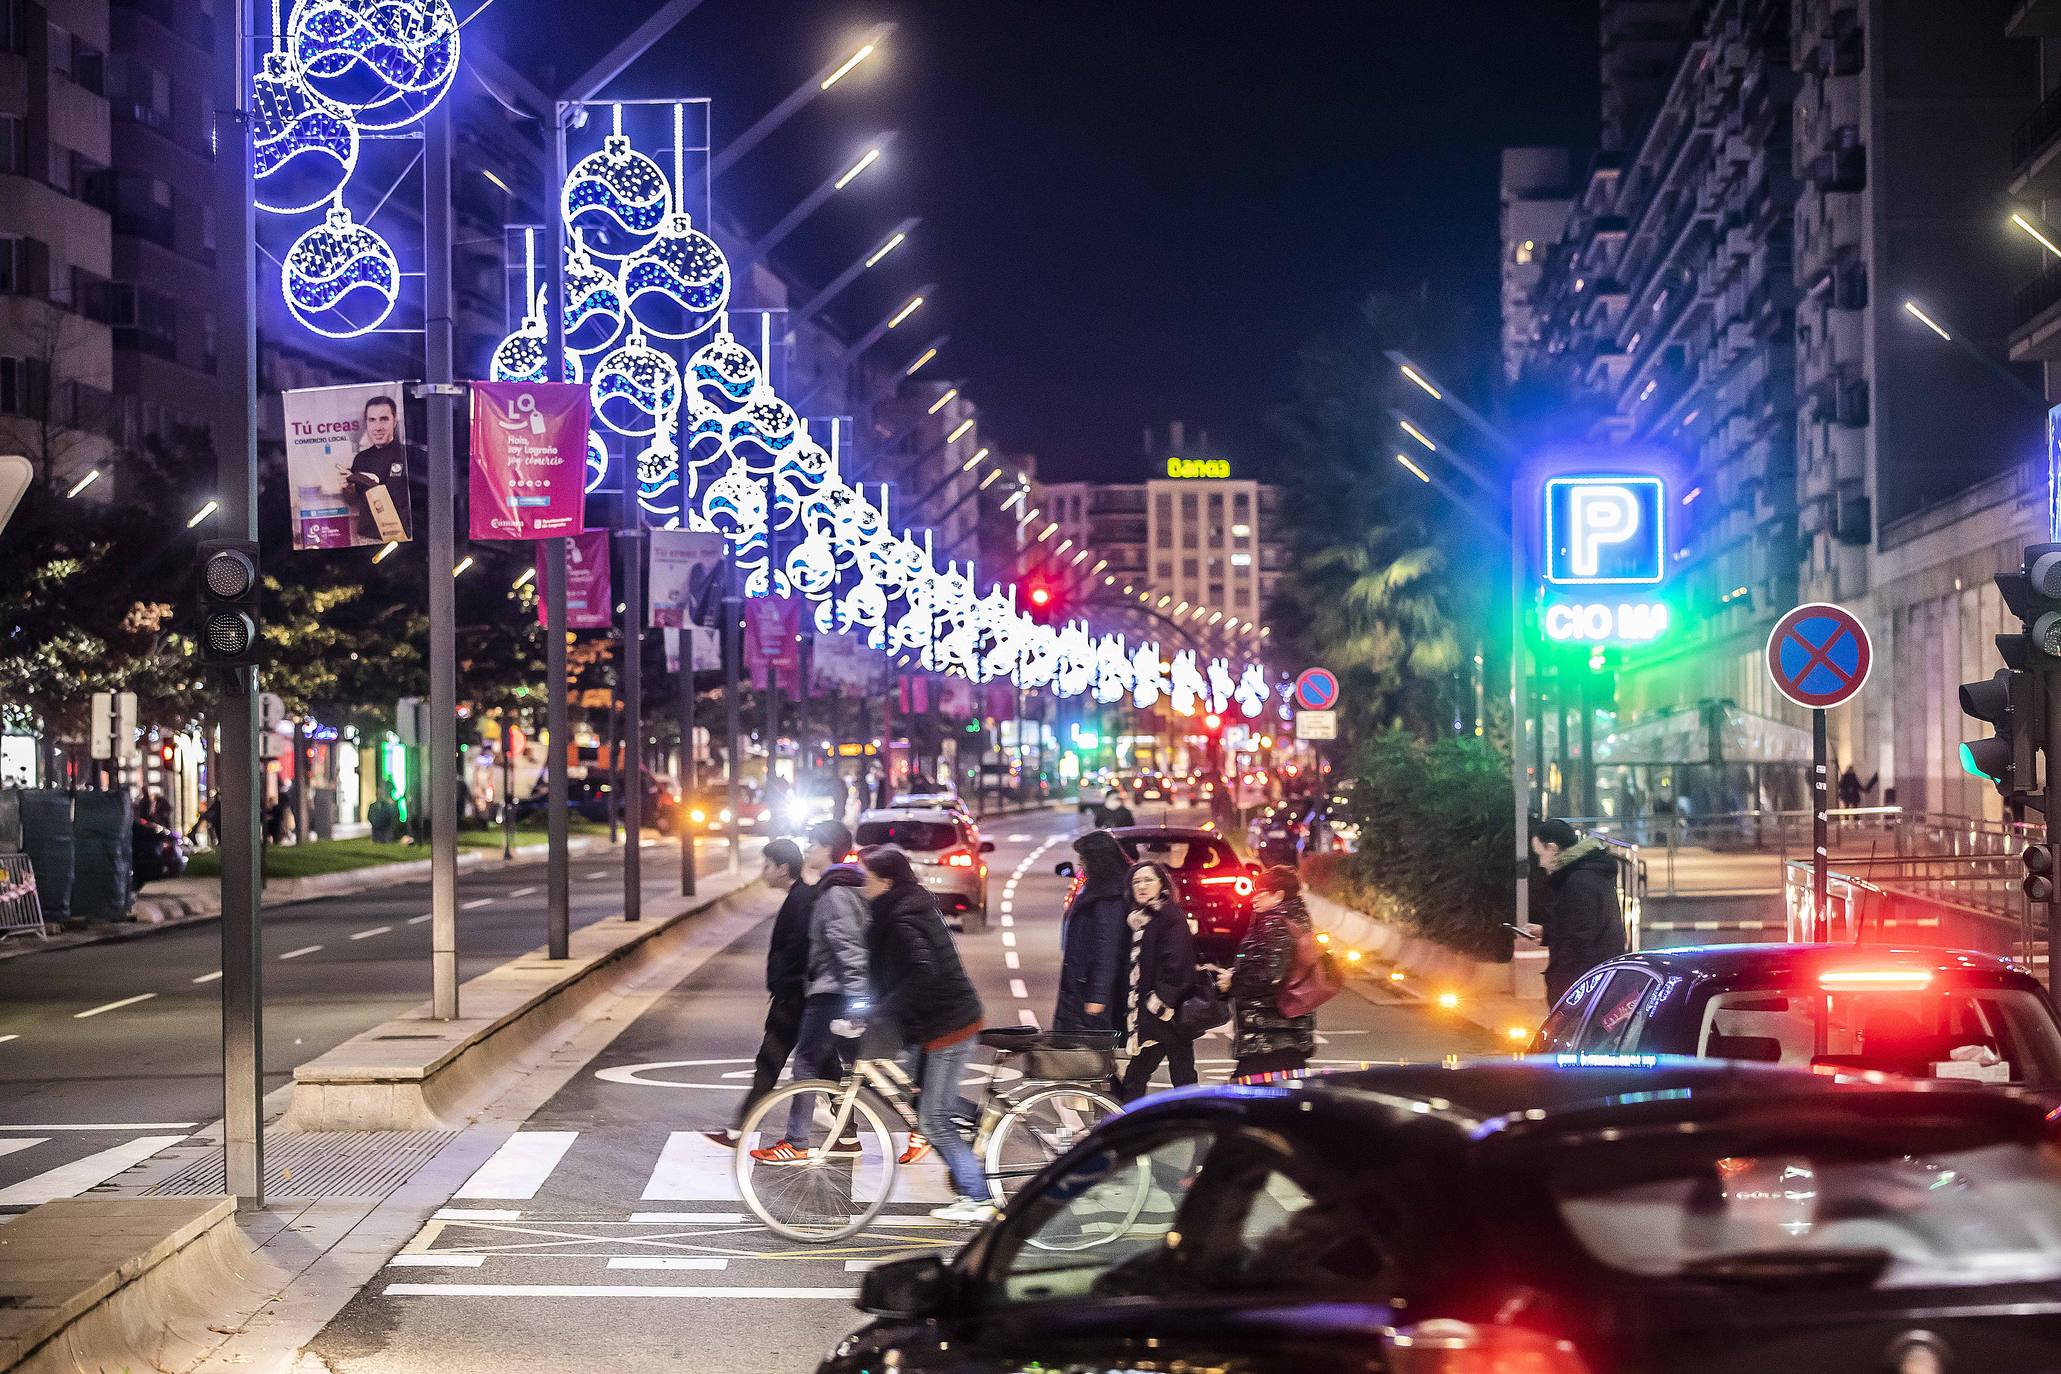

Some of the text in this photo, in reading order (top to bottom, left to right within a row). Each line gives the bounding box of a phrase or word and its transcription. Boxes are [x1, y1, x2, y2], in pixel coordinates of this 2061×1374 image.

[291, 420, 360, 435] Tú creas
[294, 437, 327, 445] COMERCIO
[508, 435, 529, 446] Hola,
[525, 445, 558, 456] Logroño
[1571, 486, 1638, 576] P
